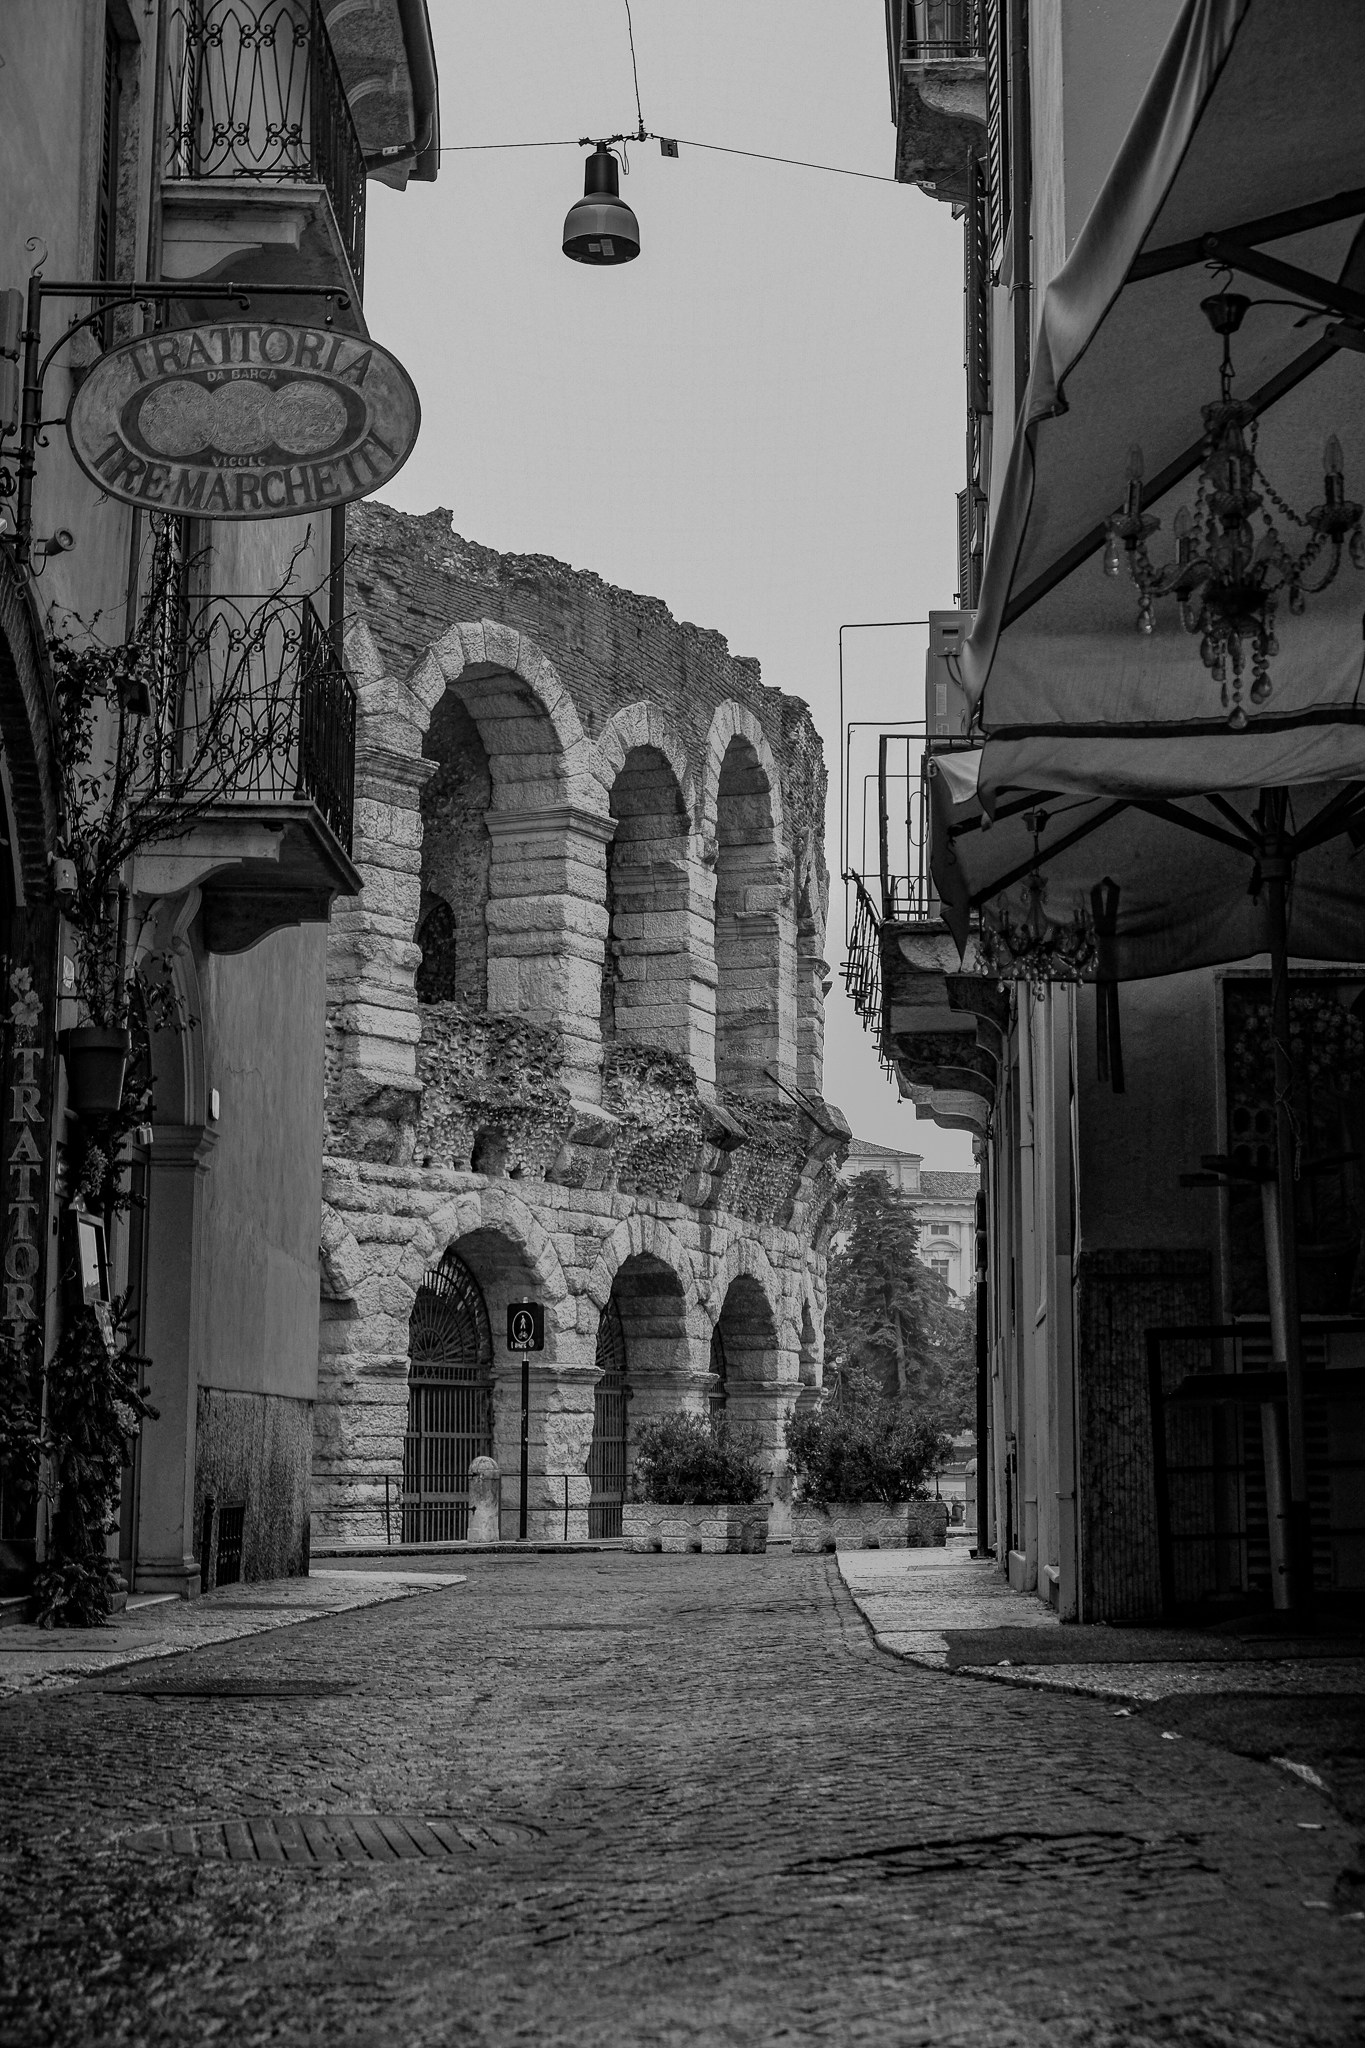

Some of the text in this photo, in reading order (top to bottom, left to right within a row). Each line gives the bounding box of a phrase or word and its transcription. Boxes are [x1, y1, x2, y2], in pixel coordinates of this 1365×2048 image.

[667, 144, 673, 156] 5
[117, 326, 374, 387] TRATTORIA
[207, 368, 278, 382] DA BARCA
[92, 431, 400, 511] TRE MARCHETTI
